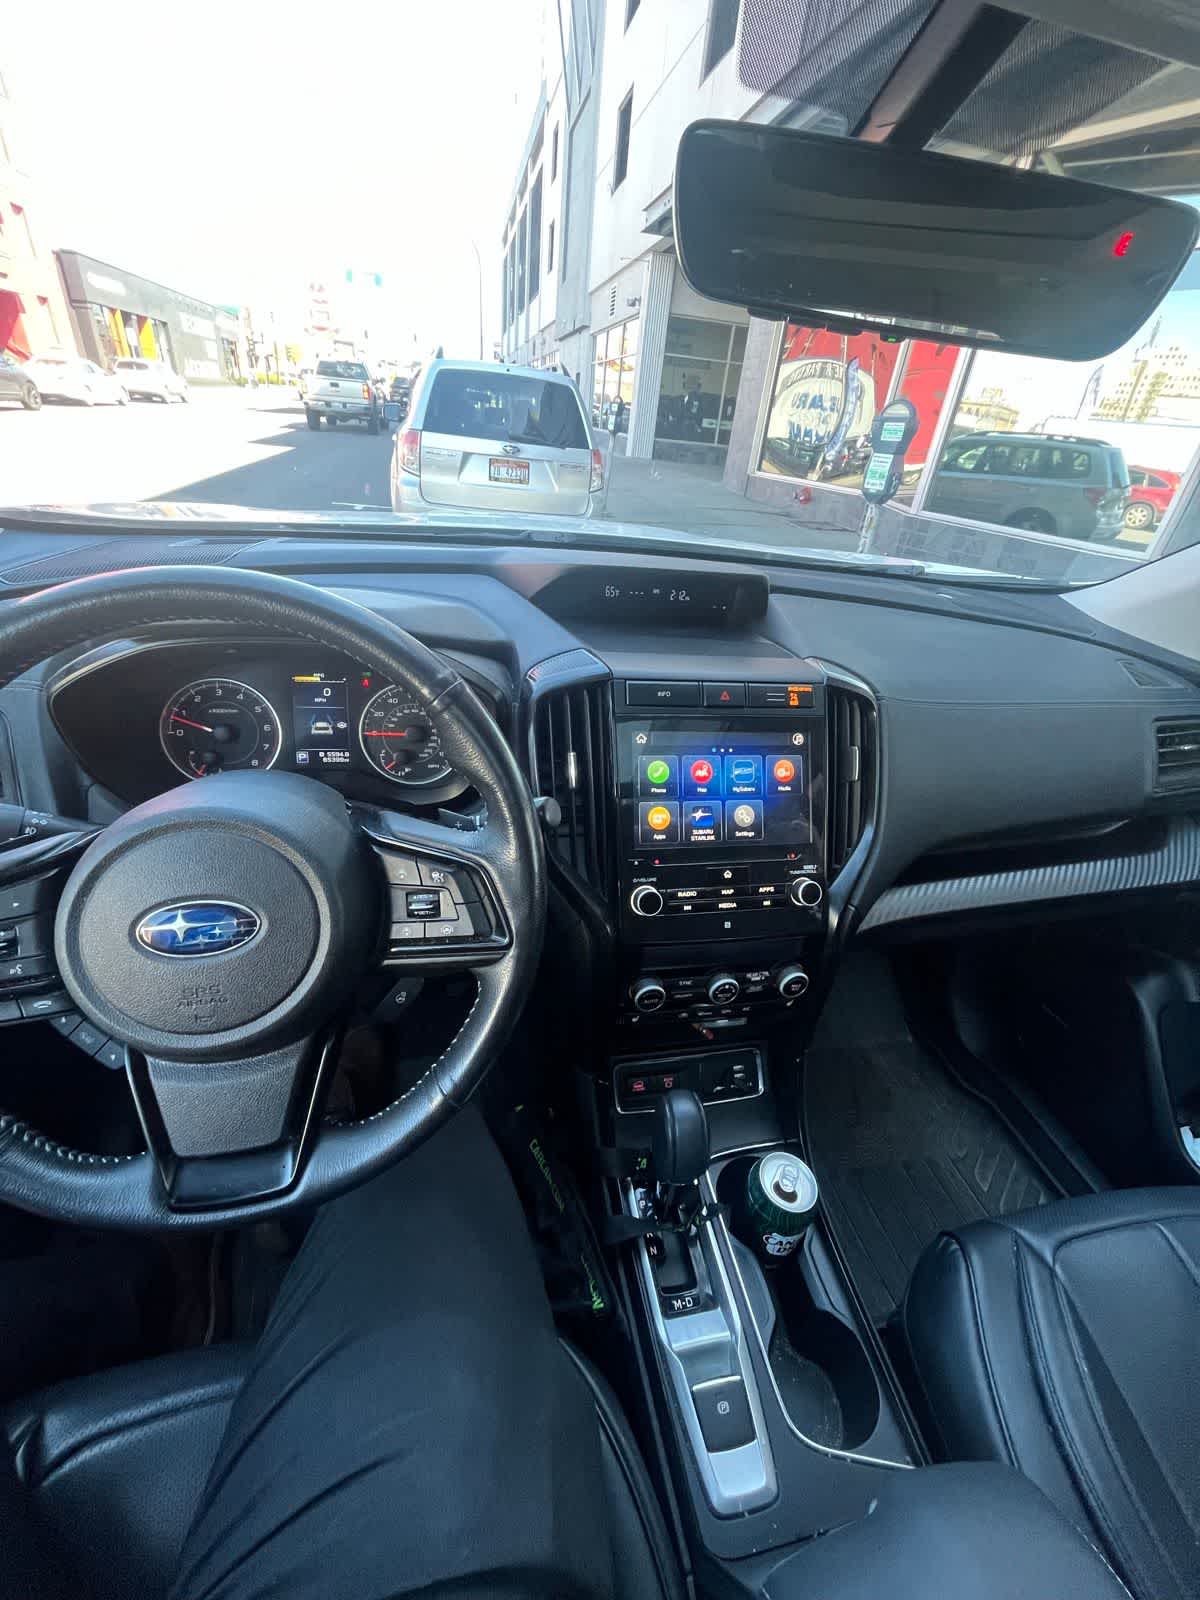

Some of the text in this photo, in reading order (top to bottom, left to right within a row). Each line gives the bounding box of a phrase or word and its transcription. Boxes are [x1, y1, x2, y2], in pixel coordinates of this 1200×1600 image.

[215, 688, 222, 696] 3
[323, 687, 331, 697] 0
[263, 743, 270, 751] 7
[650, 1246, 658, 1256] N
